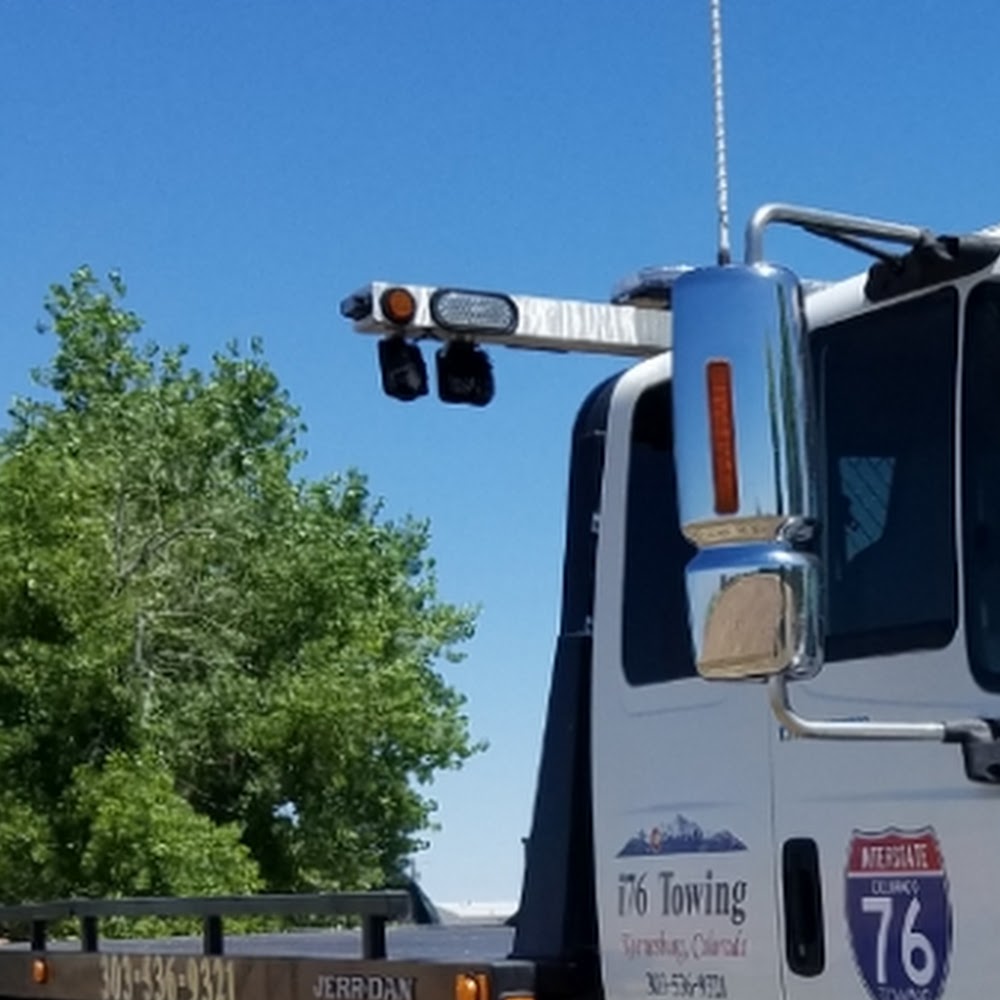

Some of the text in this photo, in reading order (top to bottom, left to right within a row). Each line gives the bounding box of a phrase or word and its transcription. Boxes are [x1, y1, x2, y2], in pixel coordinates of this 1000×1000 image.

[861, 843, 928, 870] INTERSTATE
[658, 869, 748, 926] Towing
[861, 897, 936, 986] 76
